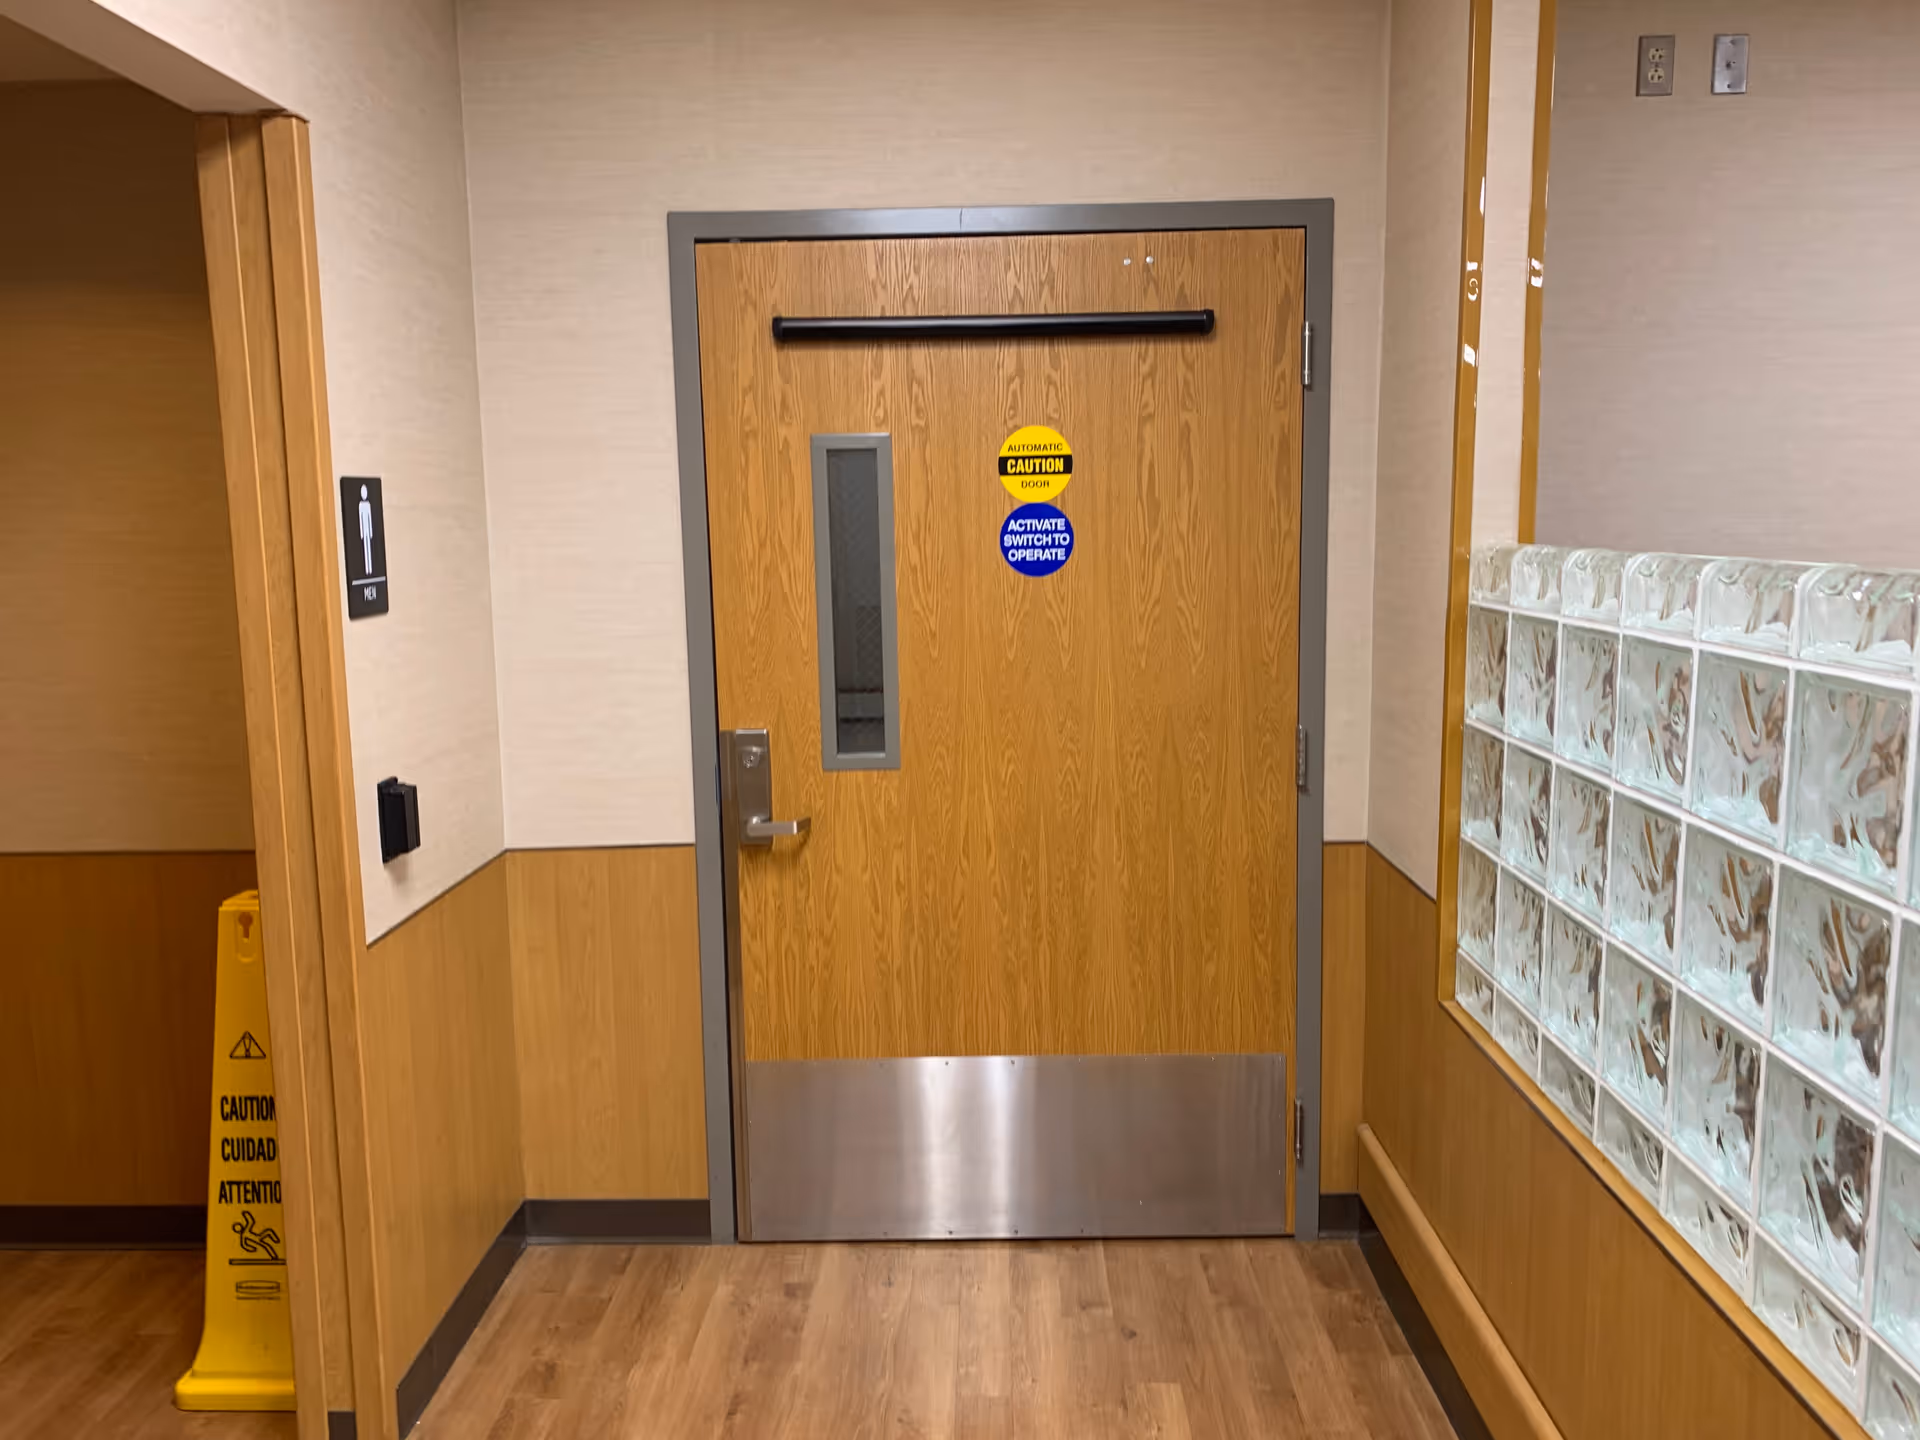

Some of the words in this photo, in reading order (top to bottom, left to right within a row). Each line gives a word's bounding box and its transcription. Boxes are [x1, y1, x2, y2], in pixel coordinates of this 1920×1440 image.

[1007, 442, 1063, 453] AUTOMATIC
[1006, 457, 1064, 474] CAUTION
[1021, 480, 1050, 489] DOOR
[1007, 518, 1066, 532] ACTIVATE
[1003, 533, 1052, 547] SWITCH
[1052, 533, 1070, 546] TO
[1007, 548, 1066, 562] OPERATE
[363, 585, 377, 602] MEN
